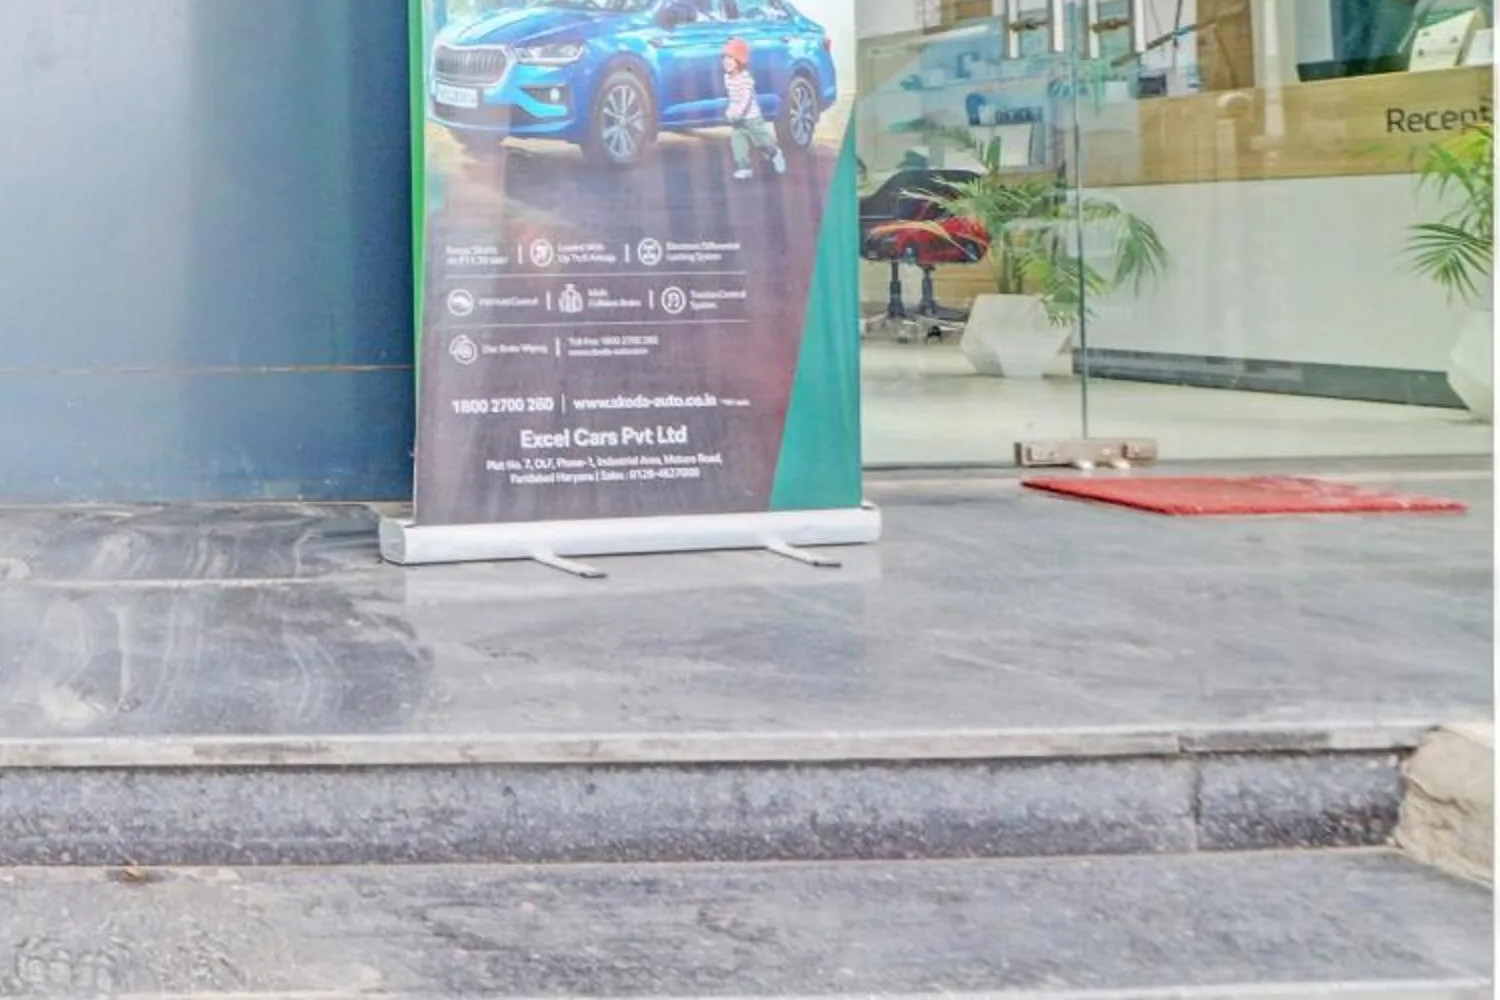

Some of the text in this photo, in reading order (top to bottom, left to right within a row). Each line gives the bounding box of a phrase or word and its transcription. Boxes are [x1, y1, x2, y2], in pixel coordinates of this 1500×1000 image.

[452, 398, 488, 414] 1800
[491, 398, 525, 413] 2700
[520, 424, 688, 449] Excel Cars Pvt Ltd
